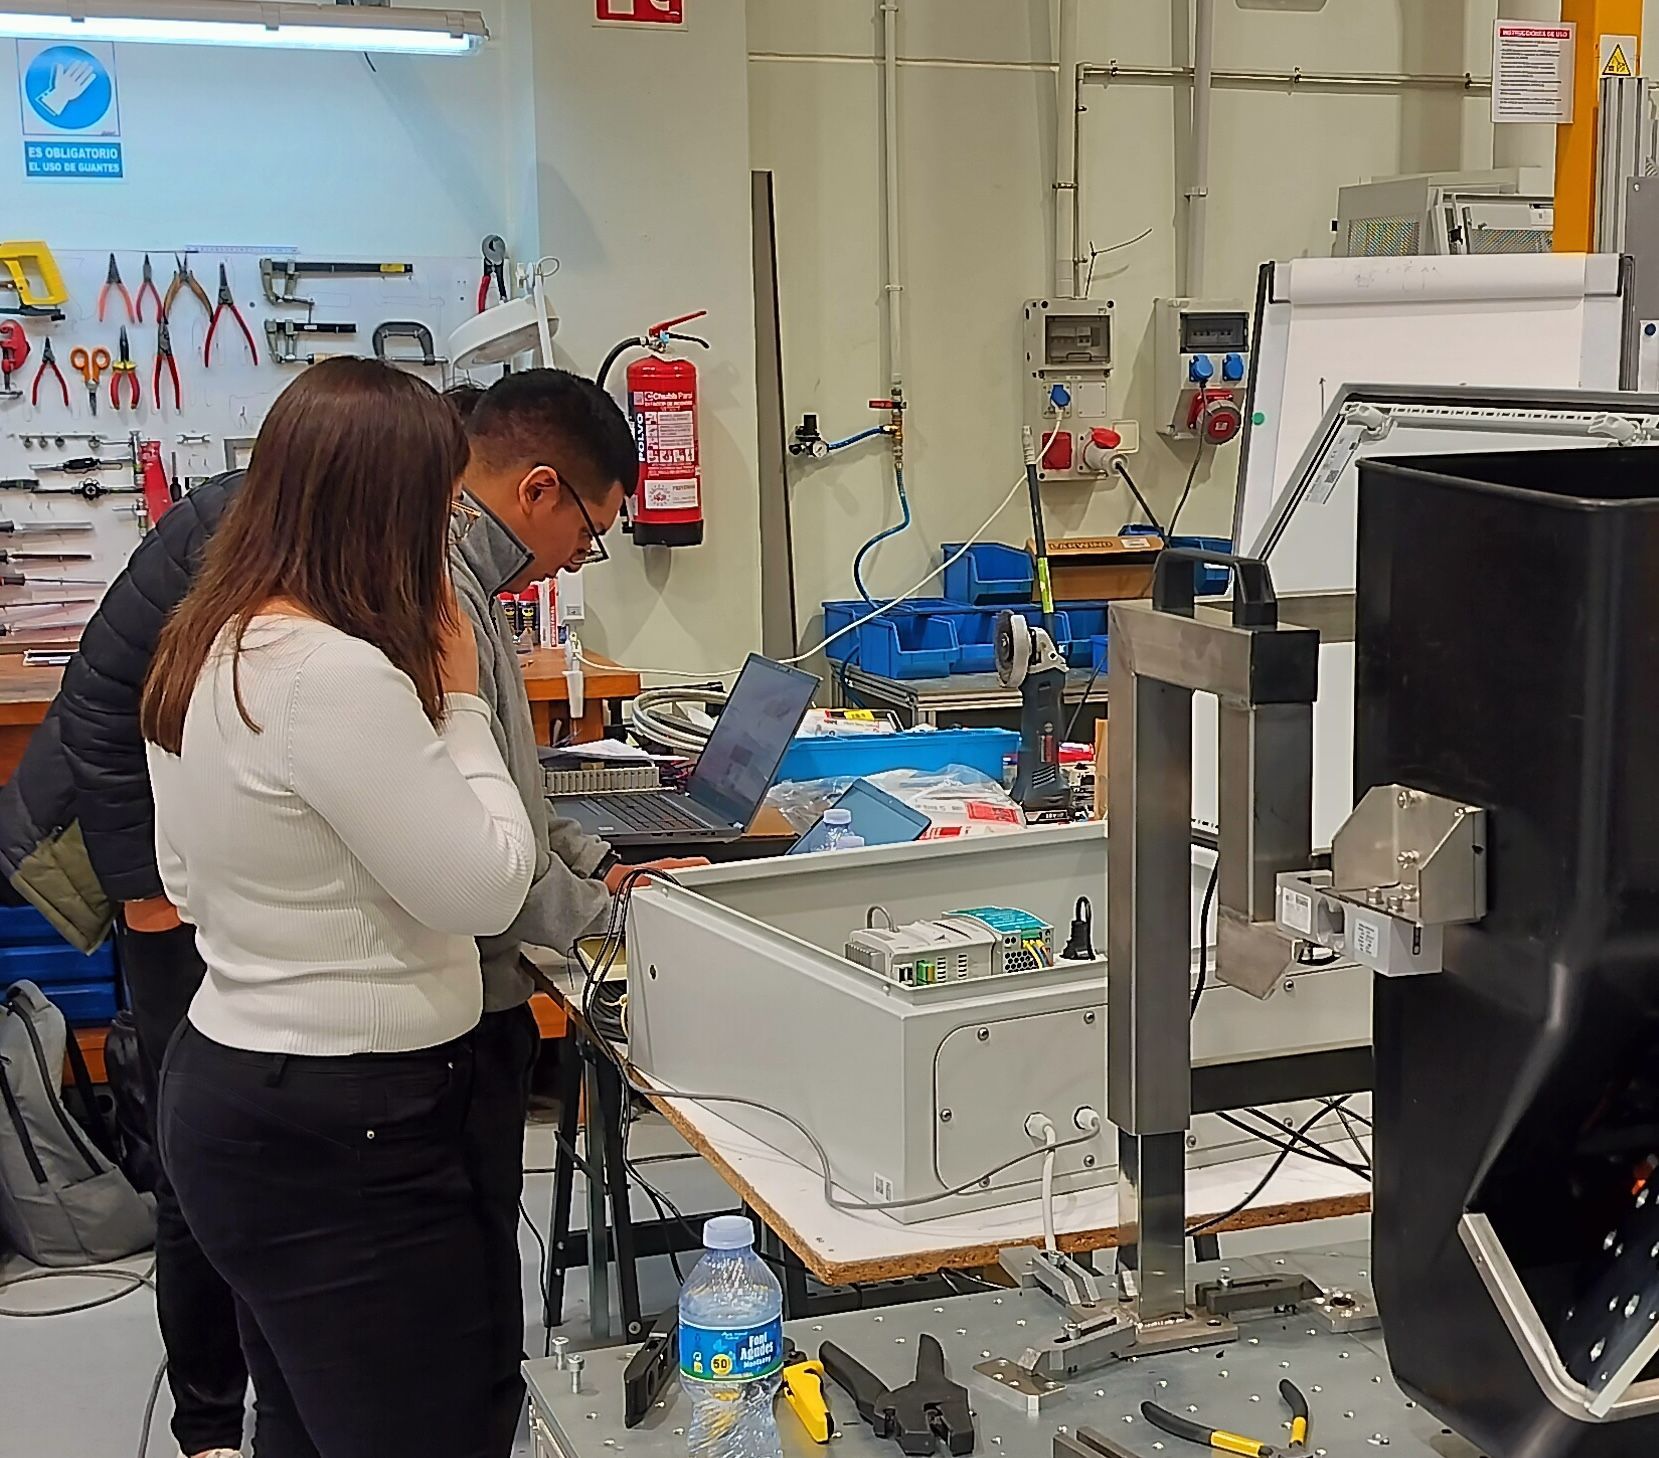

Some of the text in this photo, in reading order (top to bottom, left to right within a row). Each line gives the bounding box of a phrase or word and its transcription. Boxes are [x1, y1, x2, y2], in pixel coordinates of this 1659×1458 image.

[28, 147, 118, 159] ES OBLIGATORIO
[29, 162, 119, 173] EL USO DE GUANTES
[637, 413, 645, 462] POLVO
[749, 1331, 768, 1347] Font
[713, 1358, 727, 1369] 50
